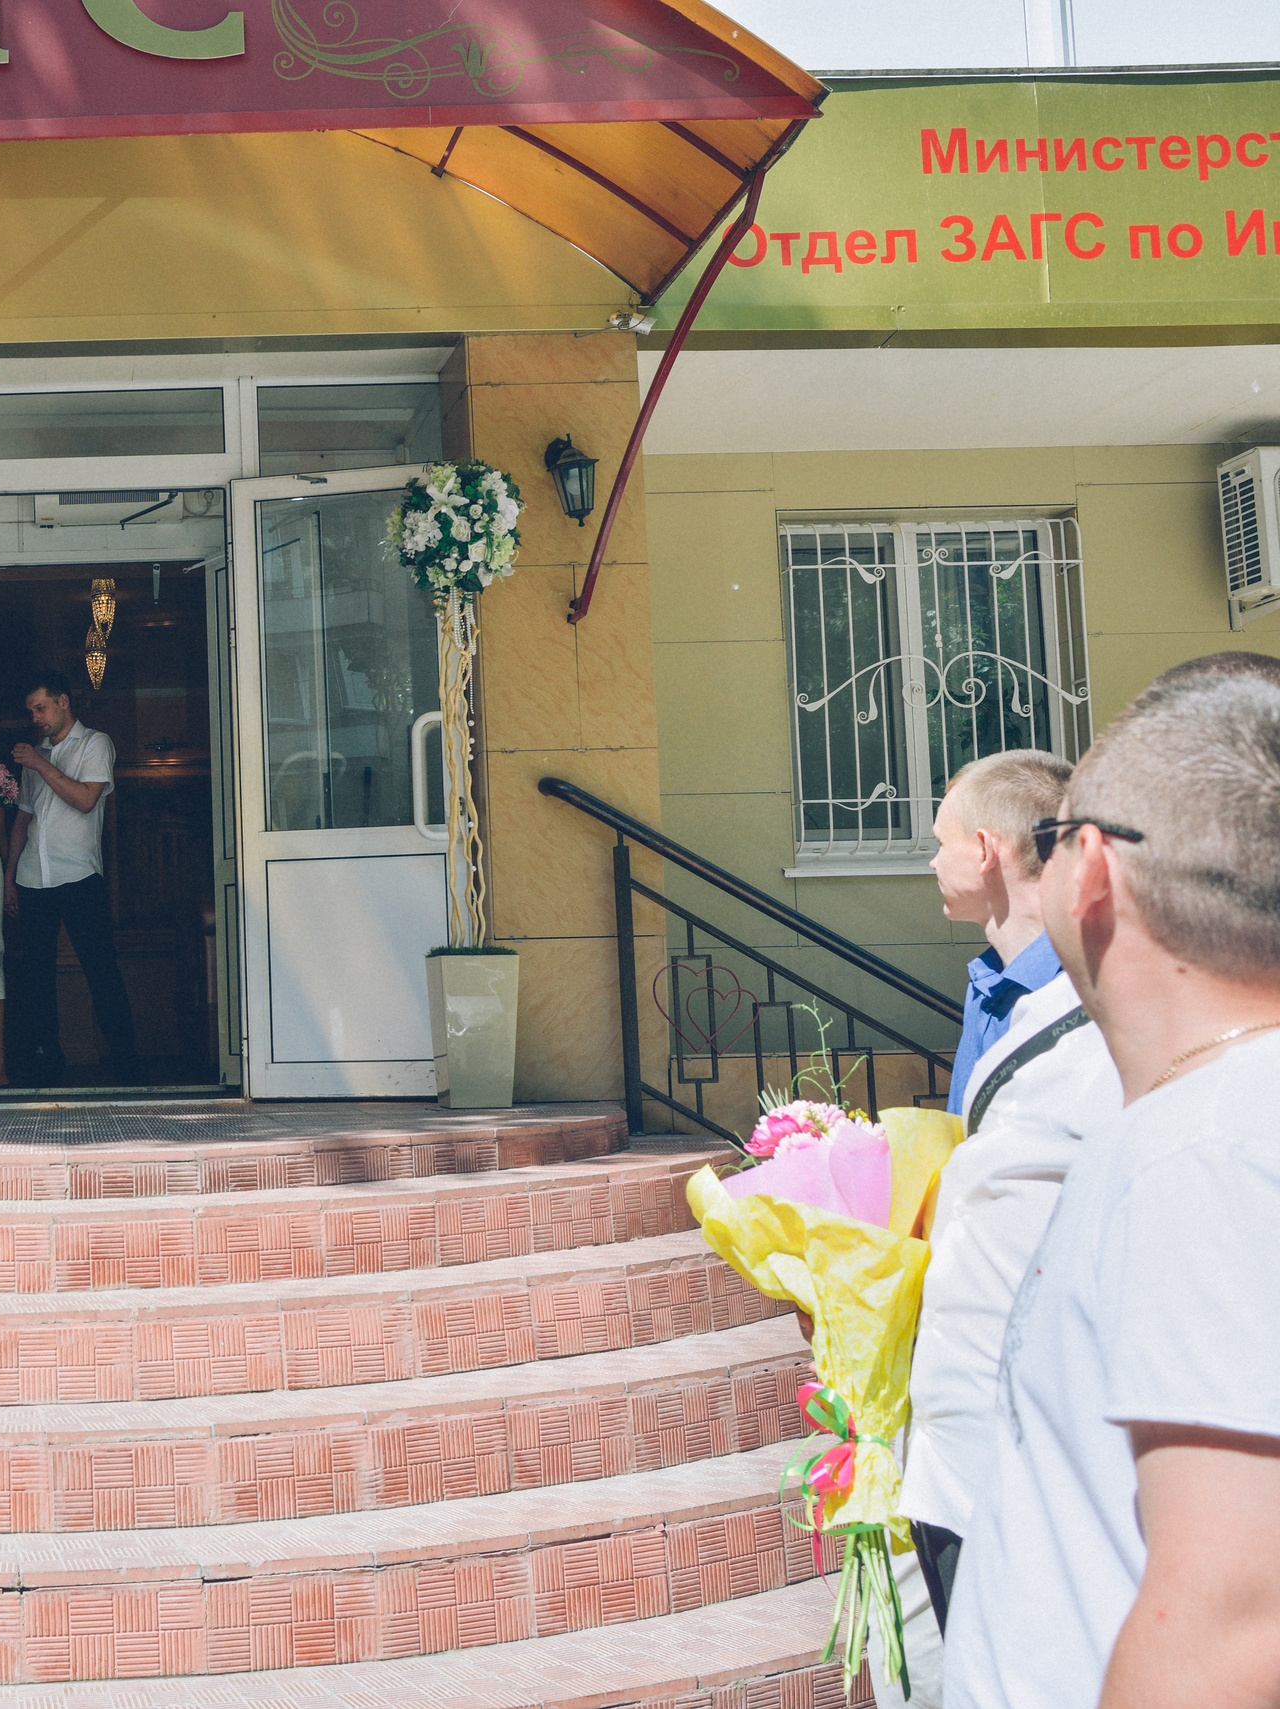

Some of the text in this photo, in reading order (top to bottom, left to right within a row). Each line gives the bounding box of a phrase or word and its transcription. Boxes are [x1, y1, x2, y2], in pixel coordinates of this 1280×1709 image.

[722, 209, 1280, 274] Отдел ЗАГС по И
